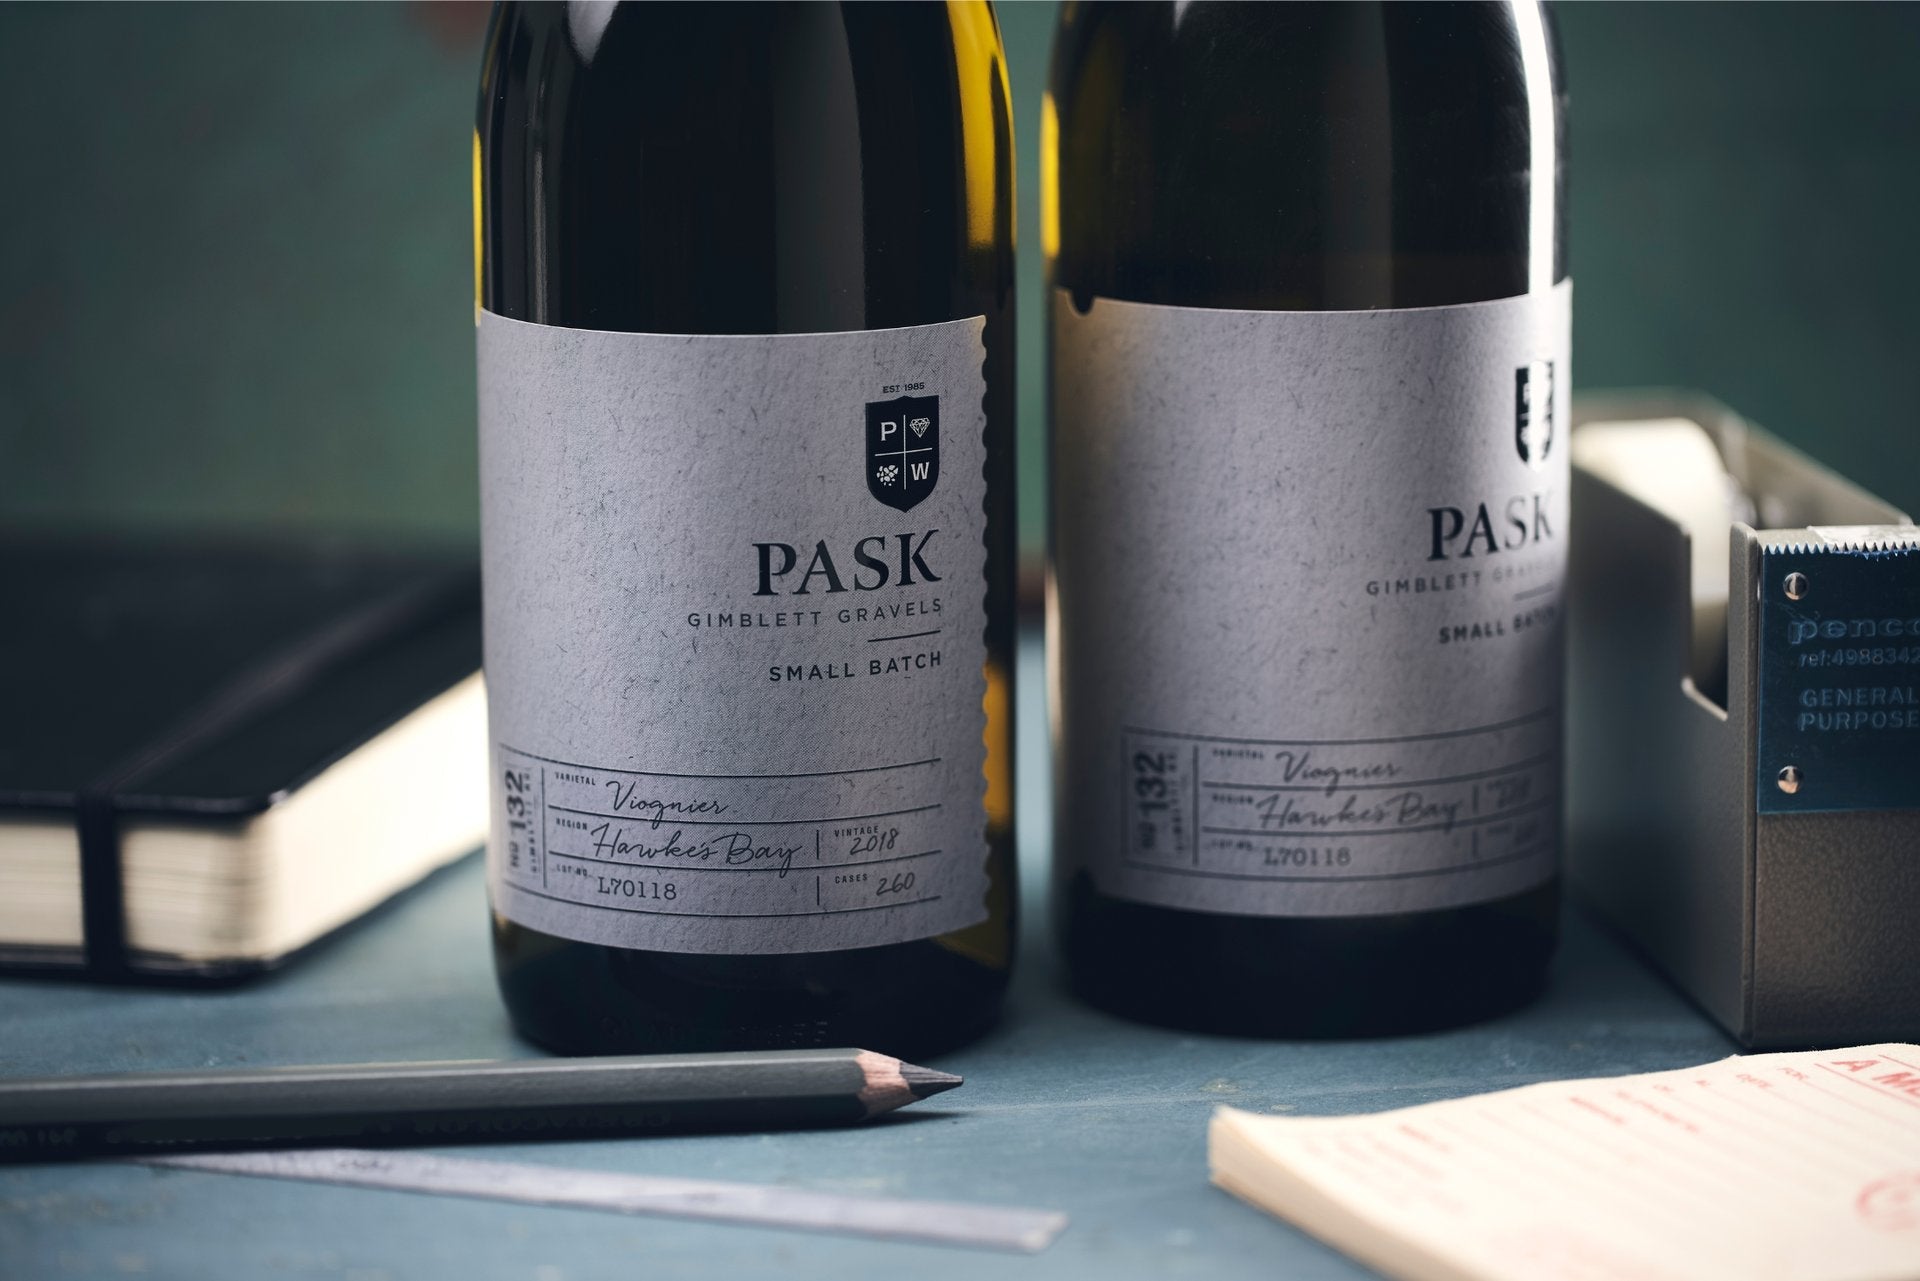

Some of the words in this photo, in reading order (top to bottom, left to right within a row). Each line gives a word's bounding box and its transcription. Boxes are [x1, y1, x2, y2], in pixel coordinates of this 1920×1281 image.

[882, 384, 901, 394] EST
[904, 382, 925, 392] 1985
[880, 421, 897, 442] P
[911, 461, 930, 481] W
[1425, 494, 1554, 562] PASK
[751, 528, 943, 596] PASK
[1366, 570, 1482, 596] GIMBLETT
[687, 611, 822, 628] GIMBLETT
[838, 598, 942, 624] GRAVELS
[1439, 618, 1505, 645] SMALL
[769, 662, 856, 682] SMALL
[869, 650, 942, 676] BATCH
[1799, 686, 1919, 708] GENERAL
[1798, 709, 1920, 732] PURPOSE
[555, 771, 596, 786] VARIETAL
[1133, 752, 1169, 818] 132
[1275, 750, 1402, 797] Viognier
[504, 769, 527, 835] 132
[606, 780, 729, 830] Viognier
[1386, 791, 1463, 834] Bay
[556, 817, 588, 831] REGION
[834, 825, 880, 838] VINTAGE
[711, 830, 803, 879] Bay
[850, 828, 899, 856] 2018
[1263, 846, 1352, 867] L70118
[598, 876, 677, 901] L70118
[834, 873, 869, 884] CASES
[876, 871, 916, 897] 260
